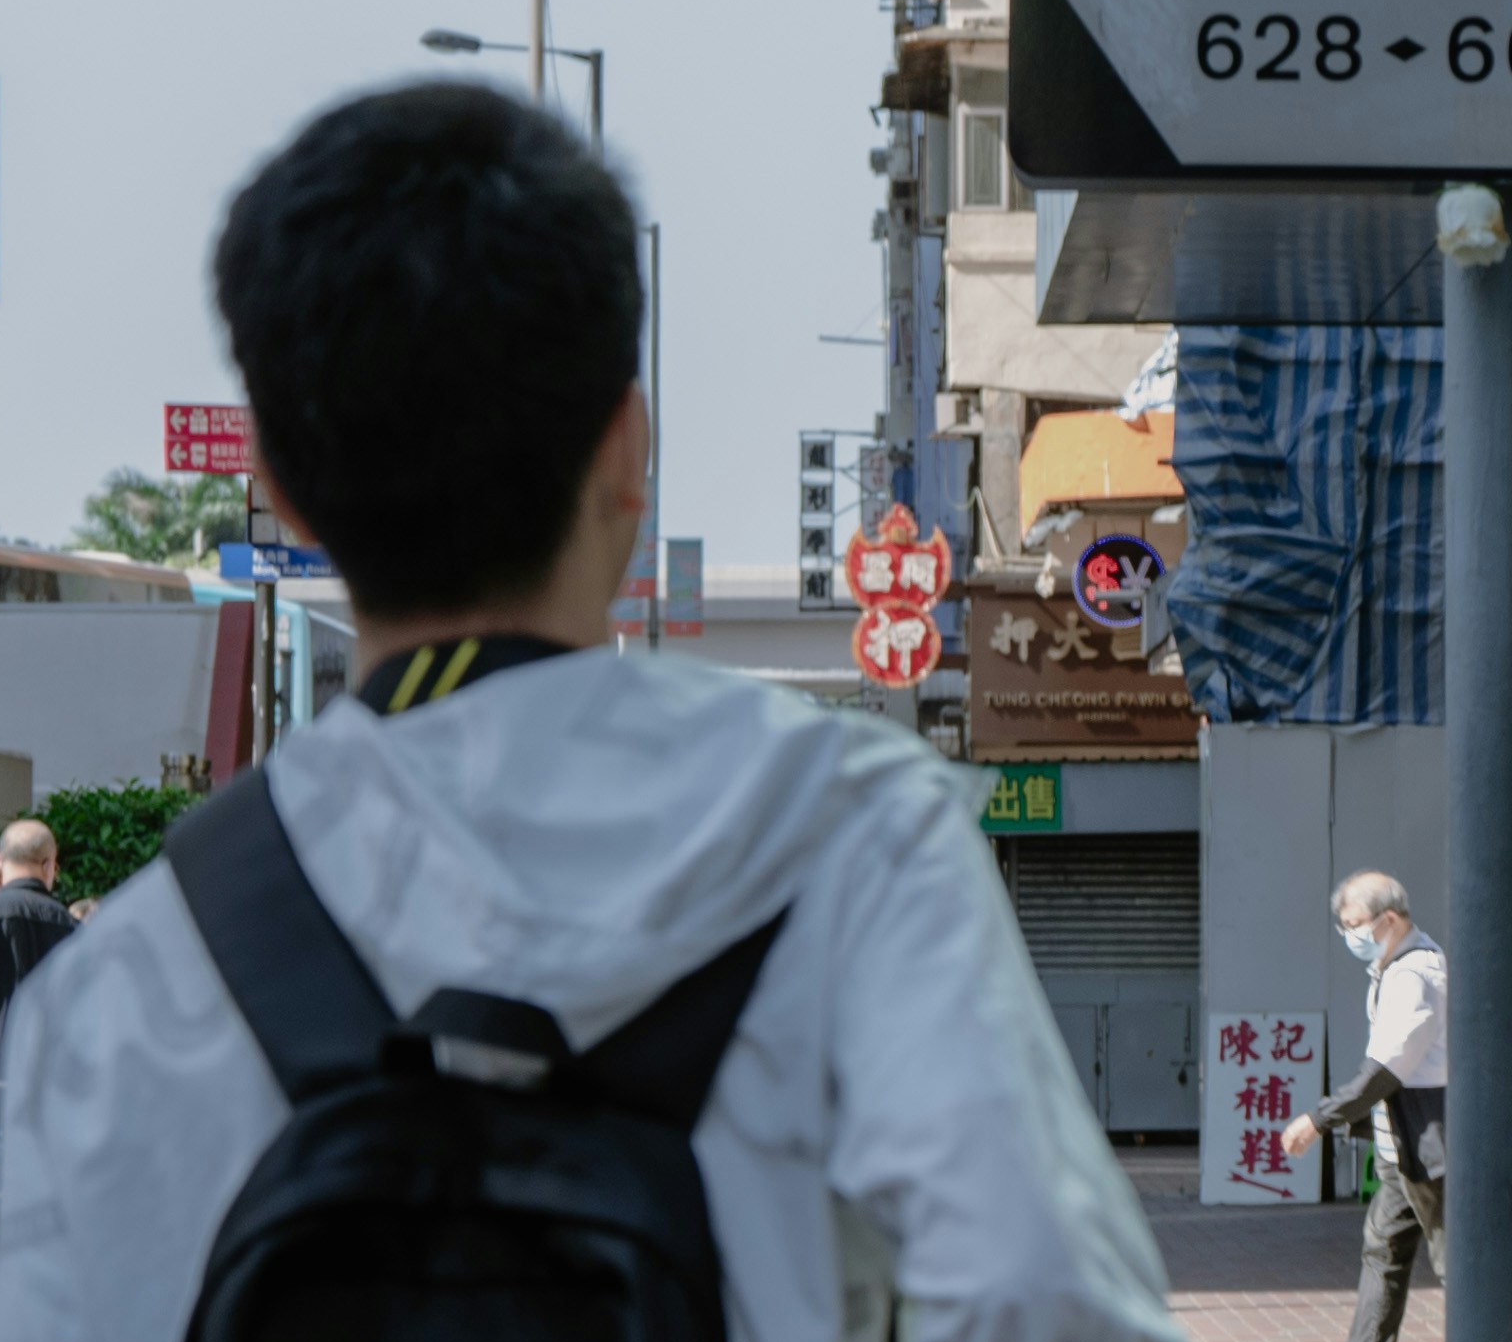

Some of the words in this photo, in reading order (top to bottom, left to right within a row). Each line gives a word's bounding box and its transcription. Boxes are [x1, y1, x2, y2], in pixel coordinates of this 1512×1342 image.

[1196, 12, 1363, 83] 628
[863, 609, 927, 677] 押
[984, 691, 1031, 707] TUNG
[1036, 691, 1110, 707] CHEONG
[1114, 691, 1166, 707] PAWN
[988, 774, 1056, 821] 出售
[1219, 1019, 1314, 1067] 陳記
